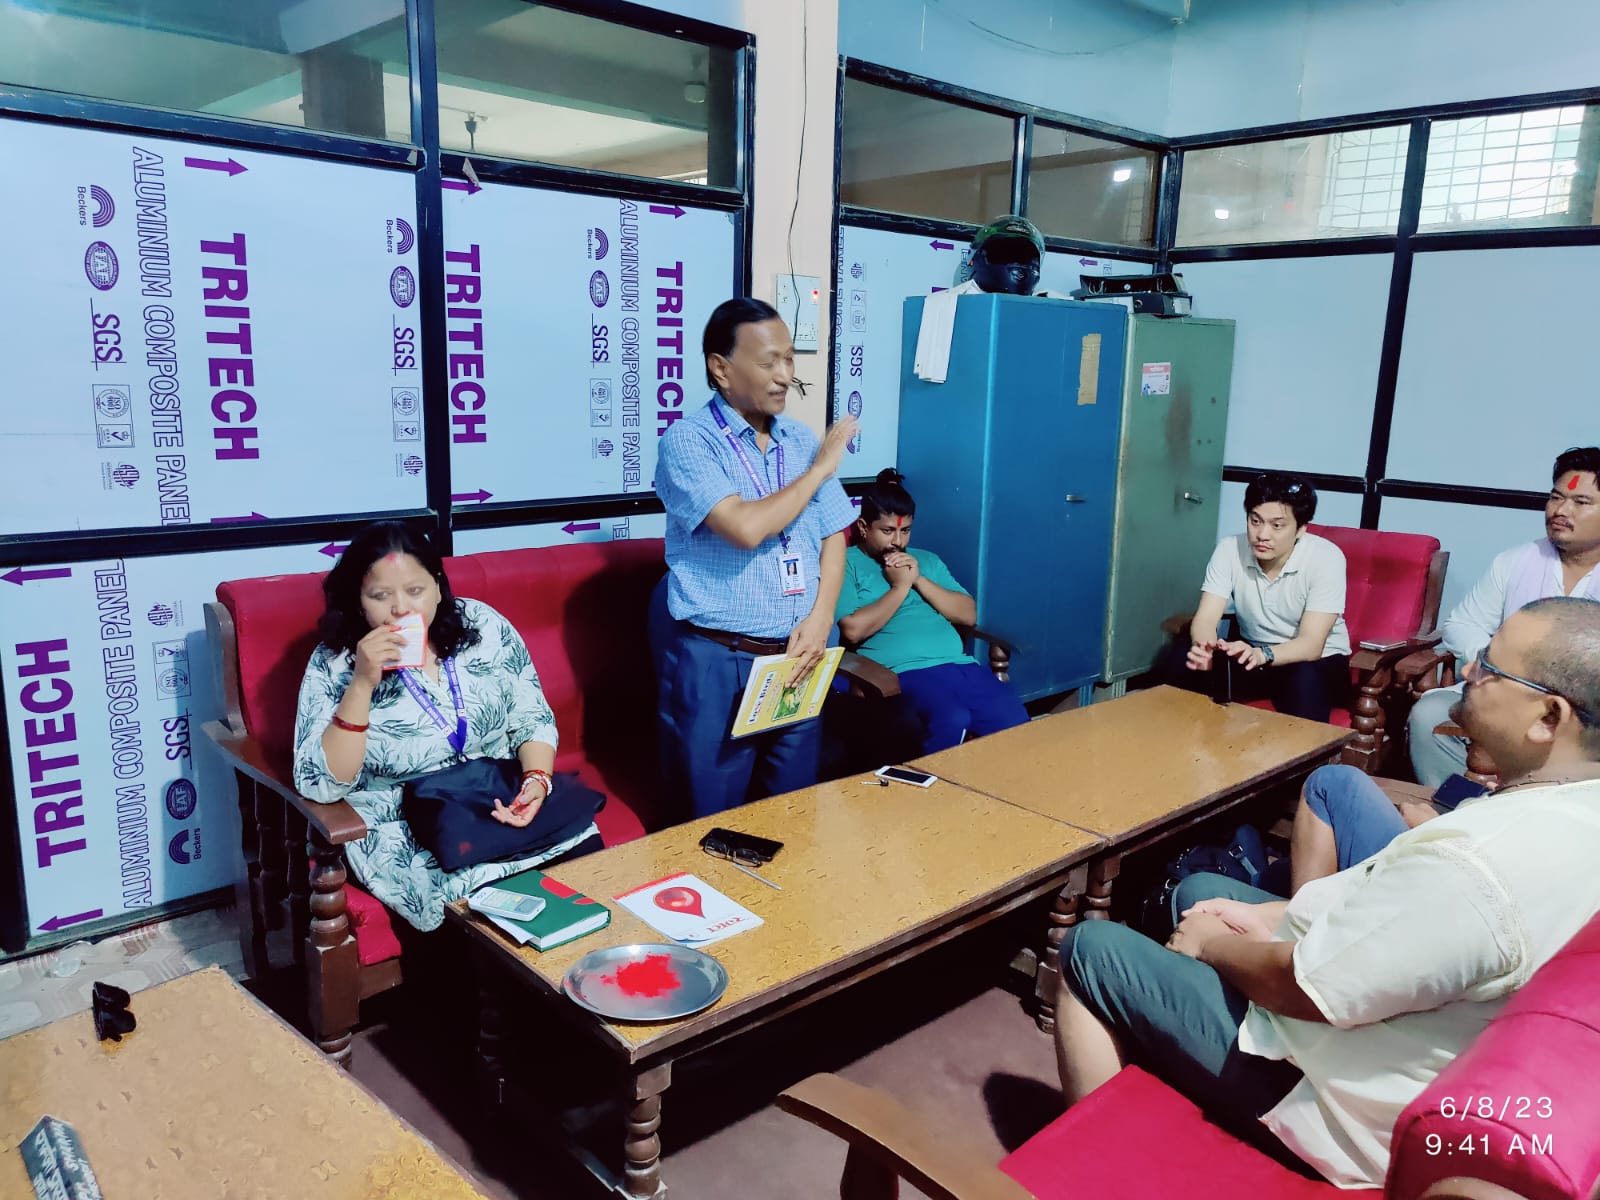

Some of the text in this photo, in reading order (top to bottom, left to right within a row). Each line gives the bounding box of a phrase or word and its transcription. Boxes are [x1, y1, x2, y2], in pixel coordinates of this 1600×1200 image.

[77, 186, 87, 226] Beckers
[386, 219, 394, 254] Beckers
[92, 313, 123, 362] SGS
[132, 146, 191, 526] ALUMINIUM COMPOSITE PANEL
[200, 232, 260, 461] TRITECH
[394, 327, 415, 368] SGS
[445, 243, 487, 444] TRITECH
[592, 325, 609, 362] SGS
[620, 199, 641, 493] ALUMINIUM COMPOSITE PANEL
[656, 260, 684, 437] TRITECH
[850, 346, 863, 377] SGS
[15, 638, 87, 868] TRITECH
[94, 558, 152, 909] ALUMINIUM COMPOSITE PANEL
[163, 716, 190, 761] SGS
[193, 827, 202, 860] Beckers
